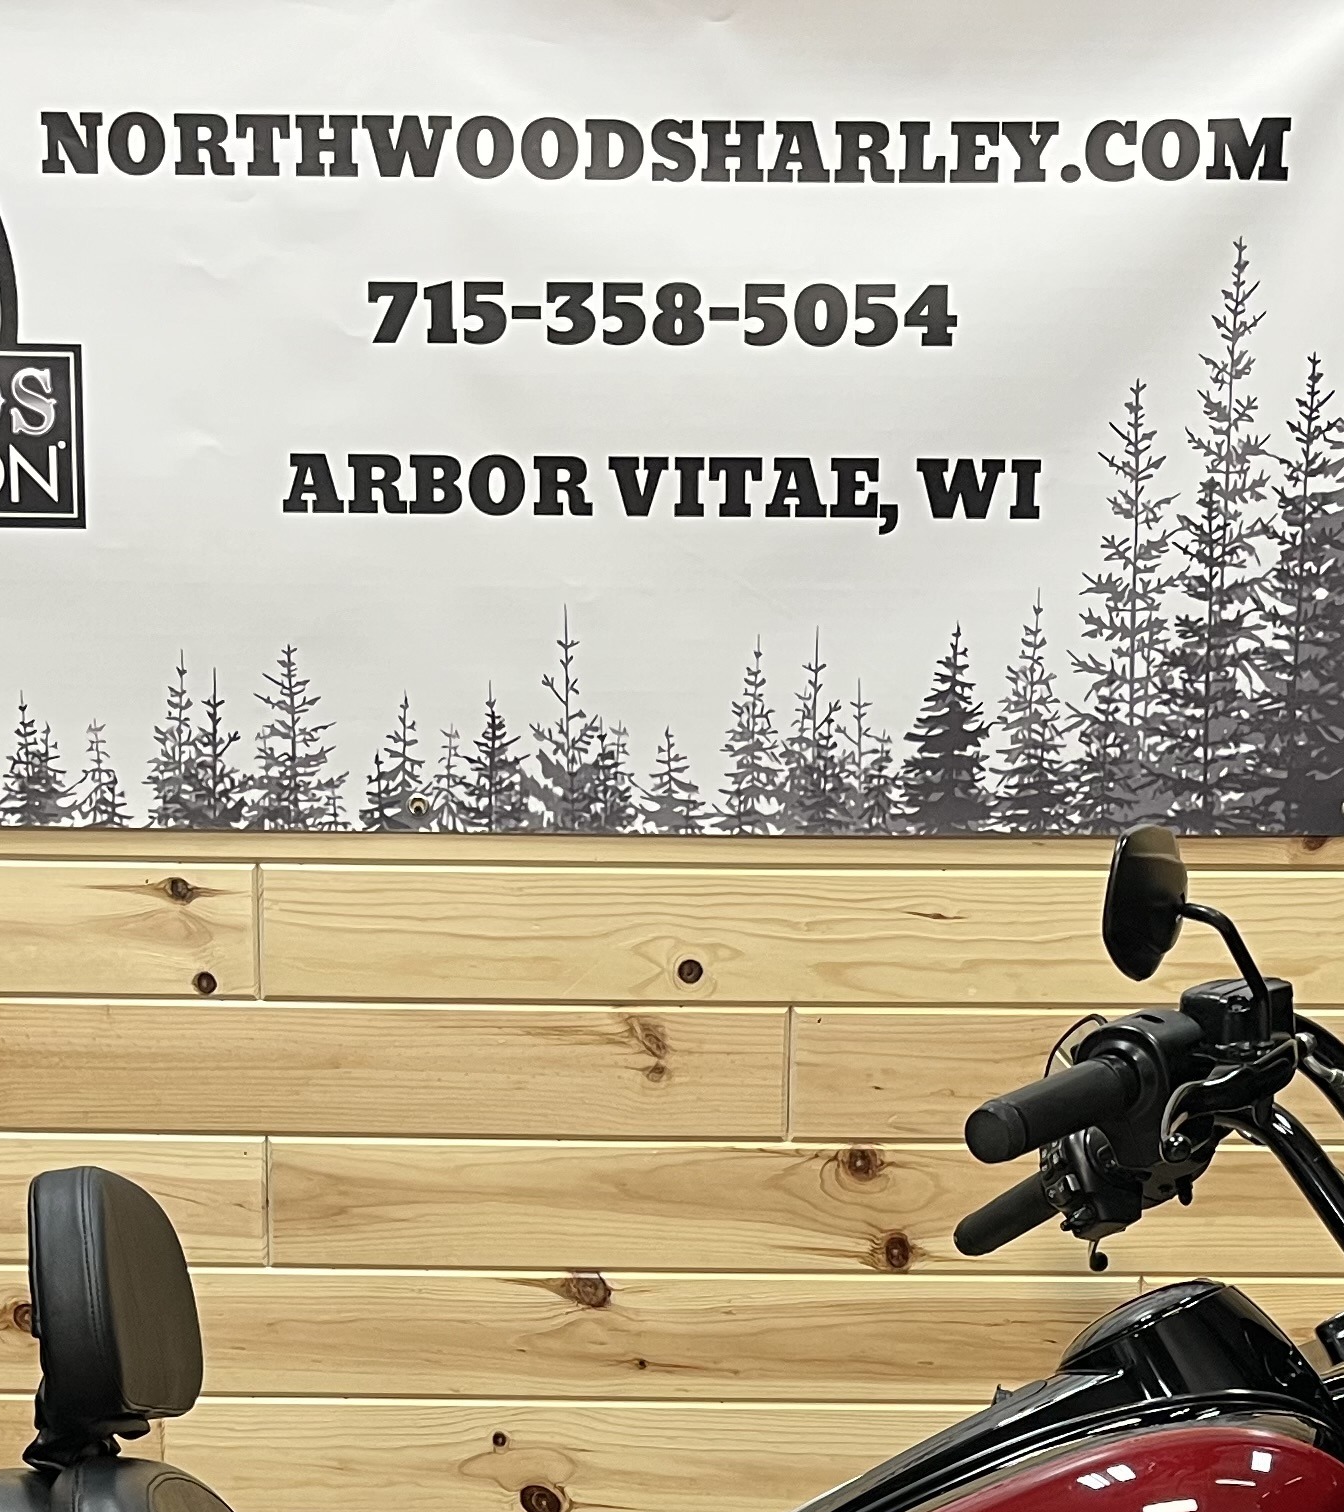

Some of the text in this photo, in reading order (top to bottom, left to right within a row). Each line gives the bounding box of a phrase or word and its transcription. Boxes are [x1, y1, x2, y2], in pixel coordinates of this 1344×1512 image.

[40, 111, 1292, 184] NORTHWOODSHARLEY.COM
[367, 280, 958, 348] 715-358-5054
[282, 453, 1042, 536] ARBOR VITAE, WI
